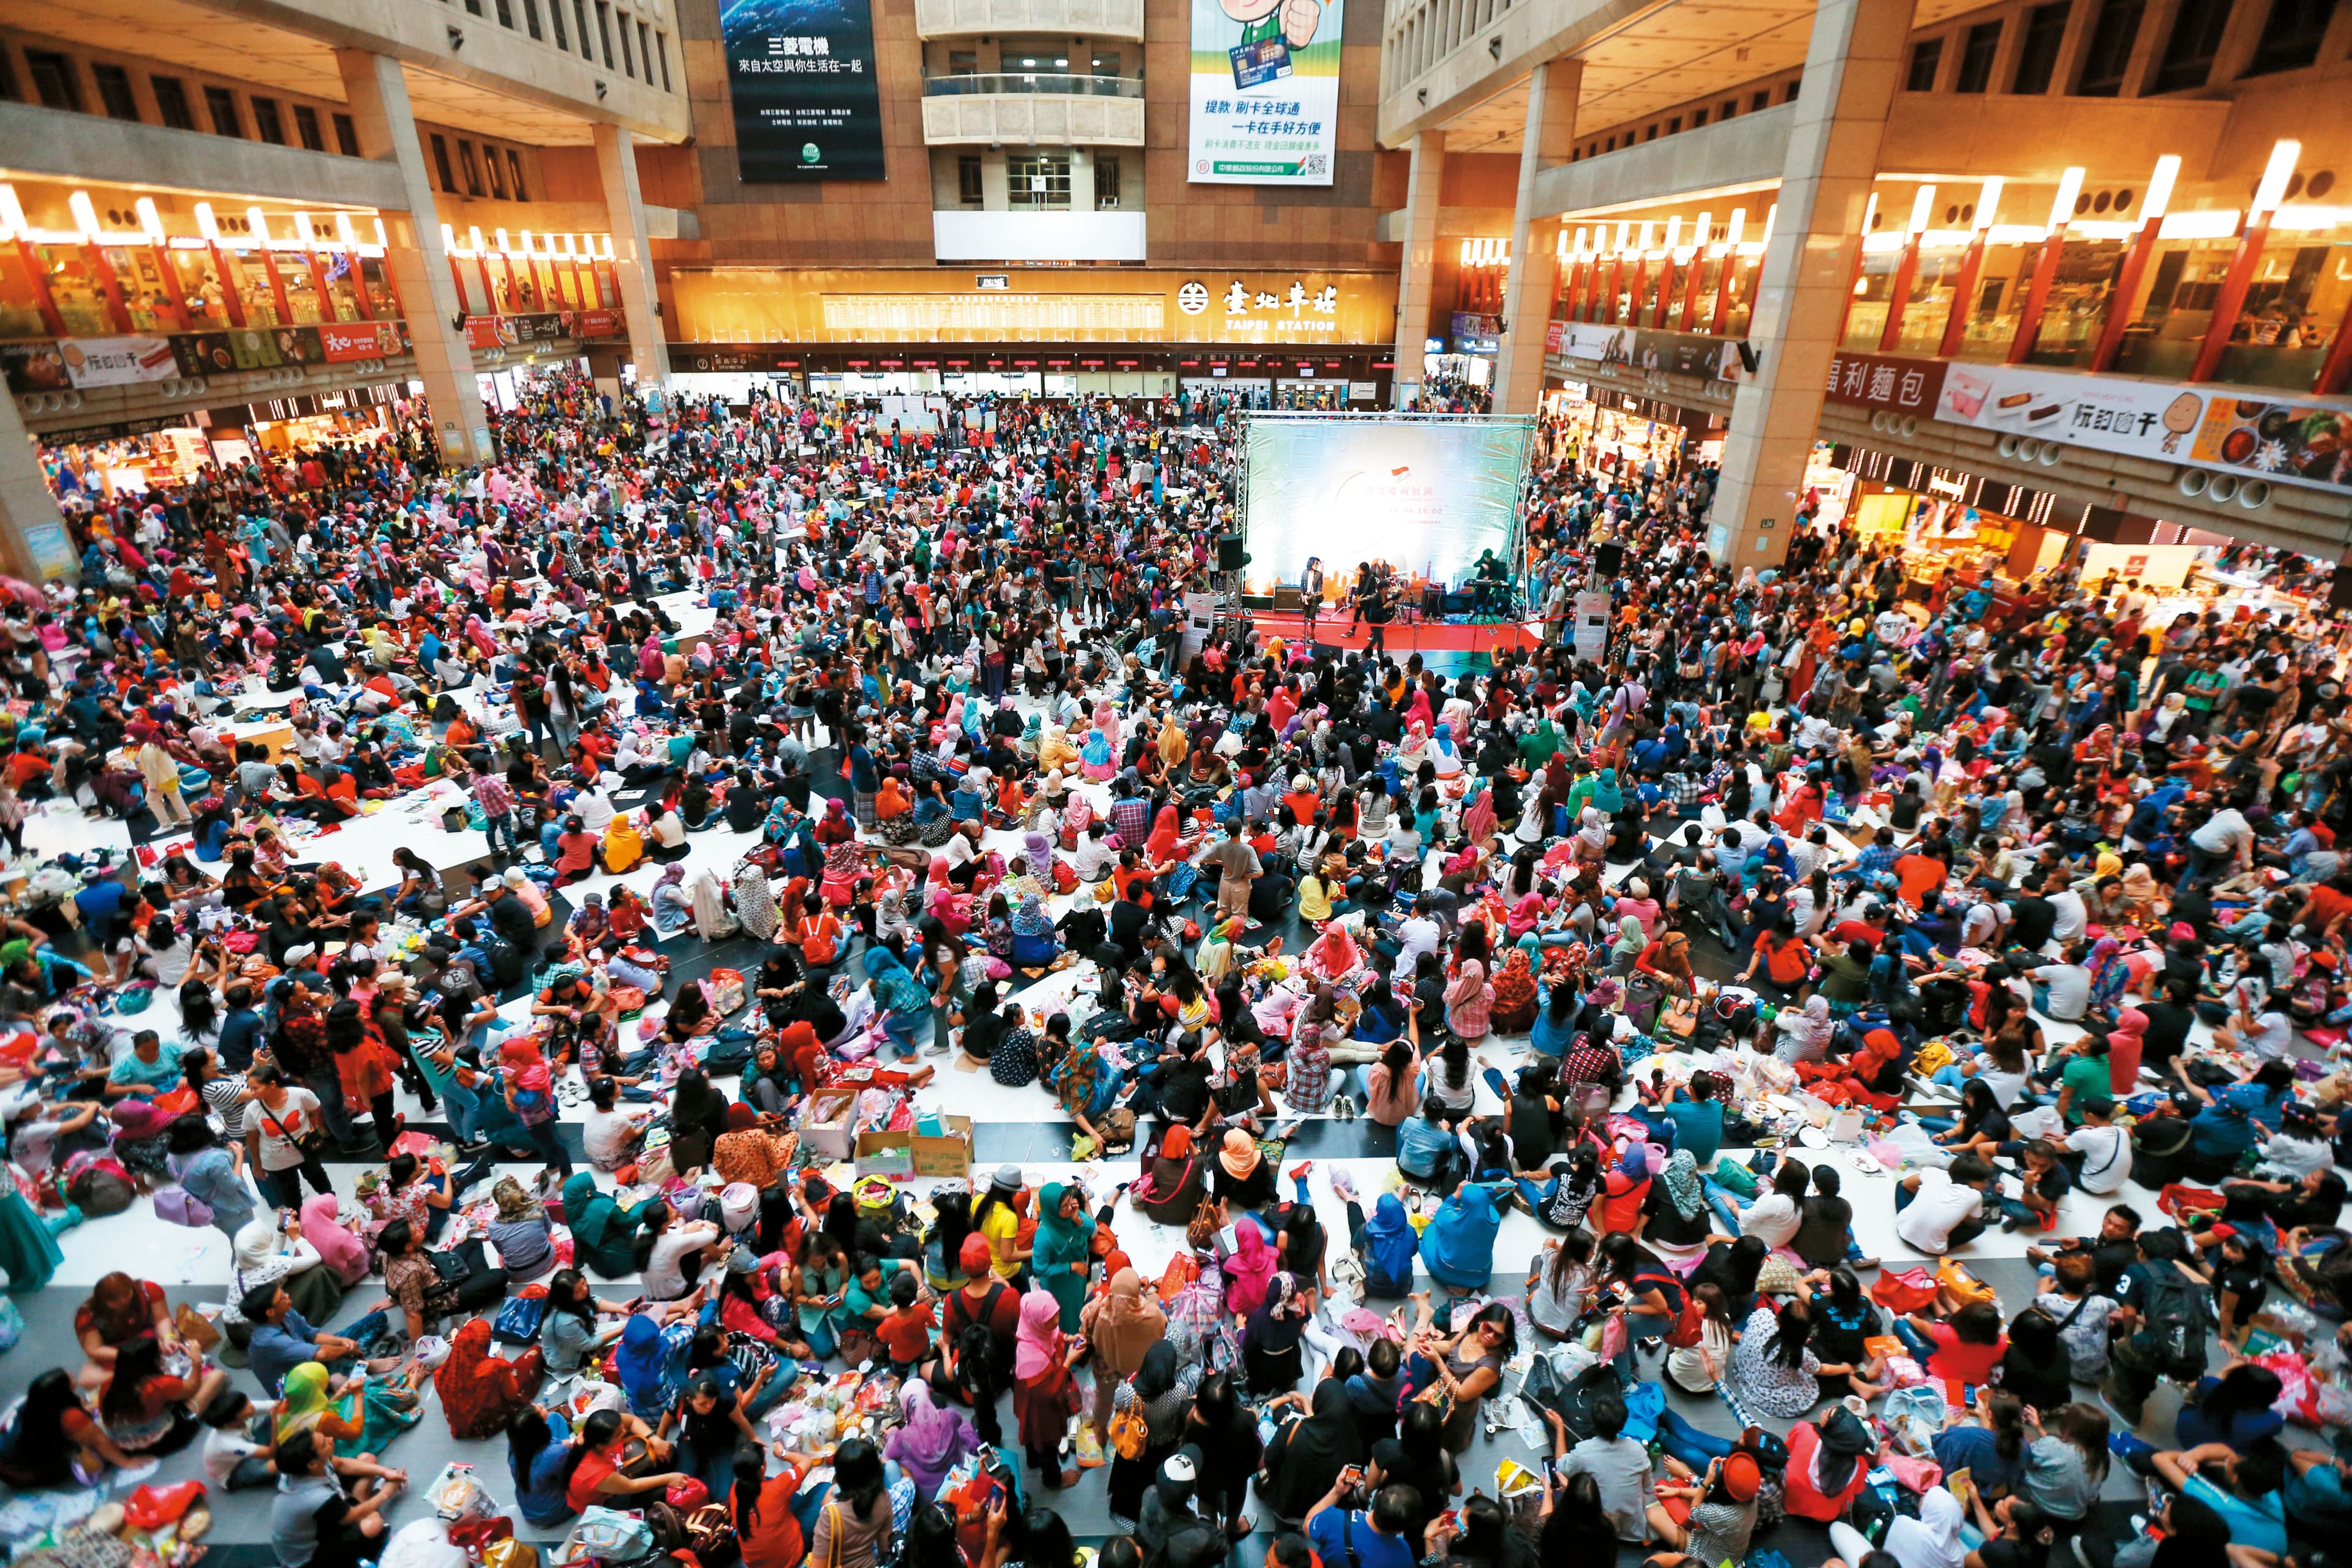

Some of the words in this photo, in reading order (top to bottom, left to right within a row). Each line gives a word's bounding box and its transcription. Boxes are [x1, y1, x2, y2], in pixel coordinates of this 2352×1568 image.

[768, 37, 829, 55] 三菱電機
[739, 59, 863, 73] 來自太空與你生活在一起
[1232, 122, 1321, 135] 一卡在手好方便
[1223, 280, 1337, 317] 臺北車站
[1226, 320, 1268, 330] TAIPEI
[1277, 320, 1335, 331] STATION
[1826, 359, 1925, 407] 福利麵包
[2116, 1274, 2132, 1294] 3
